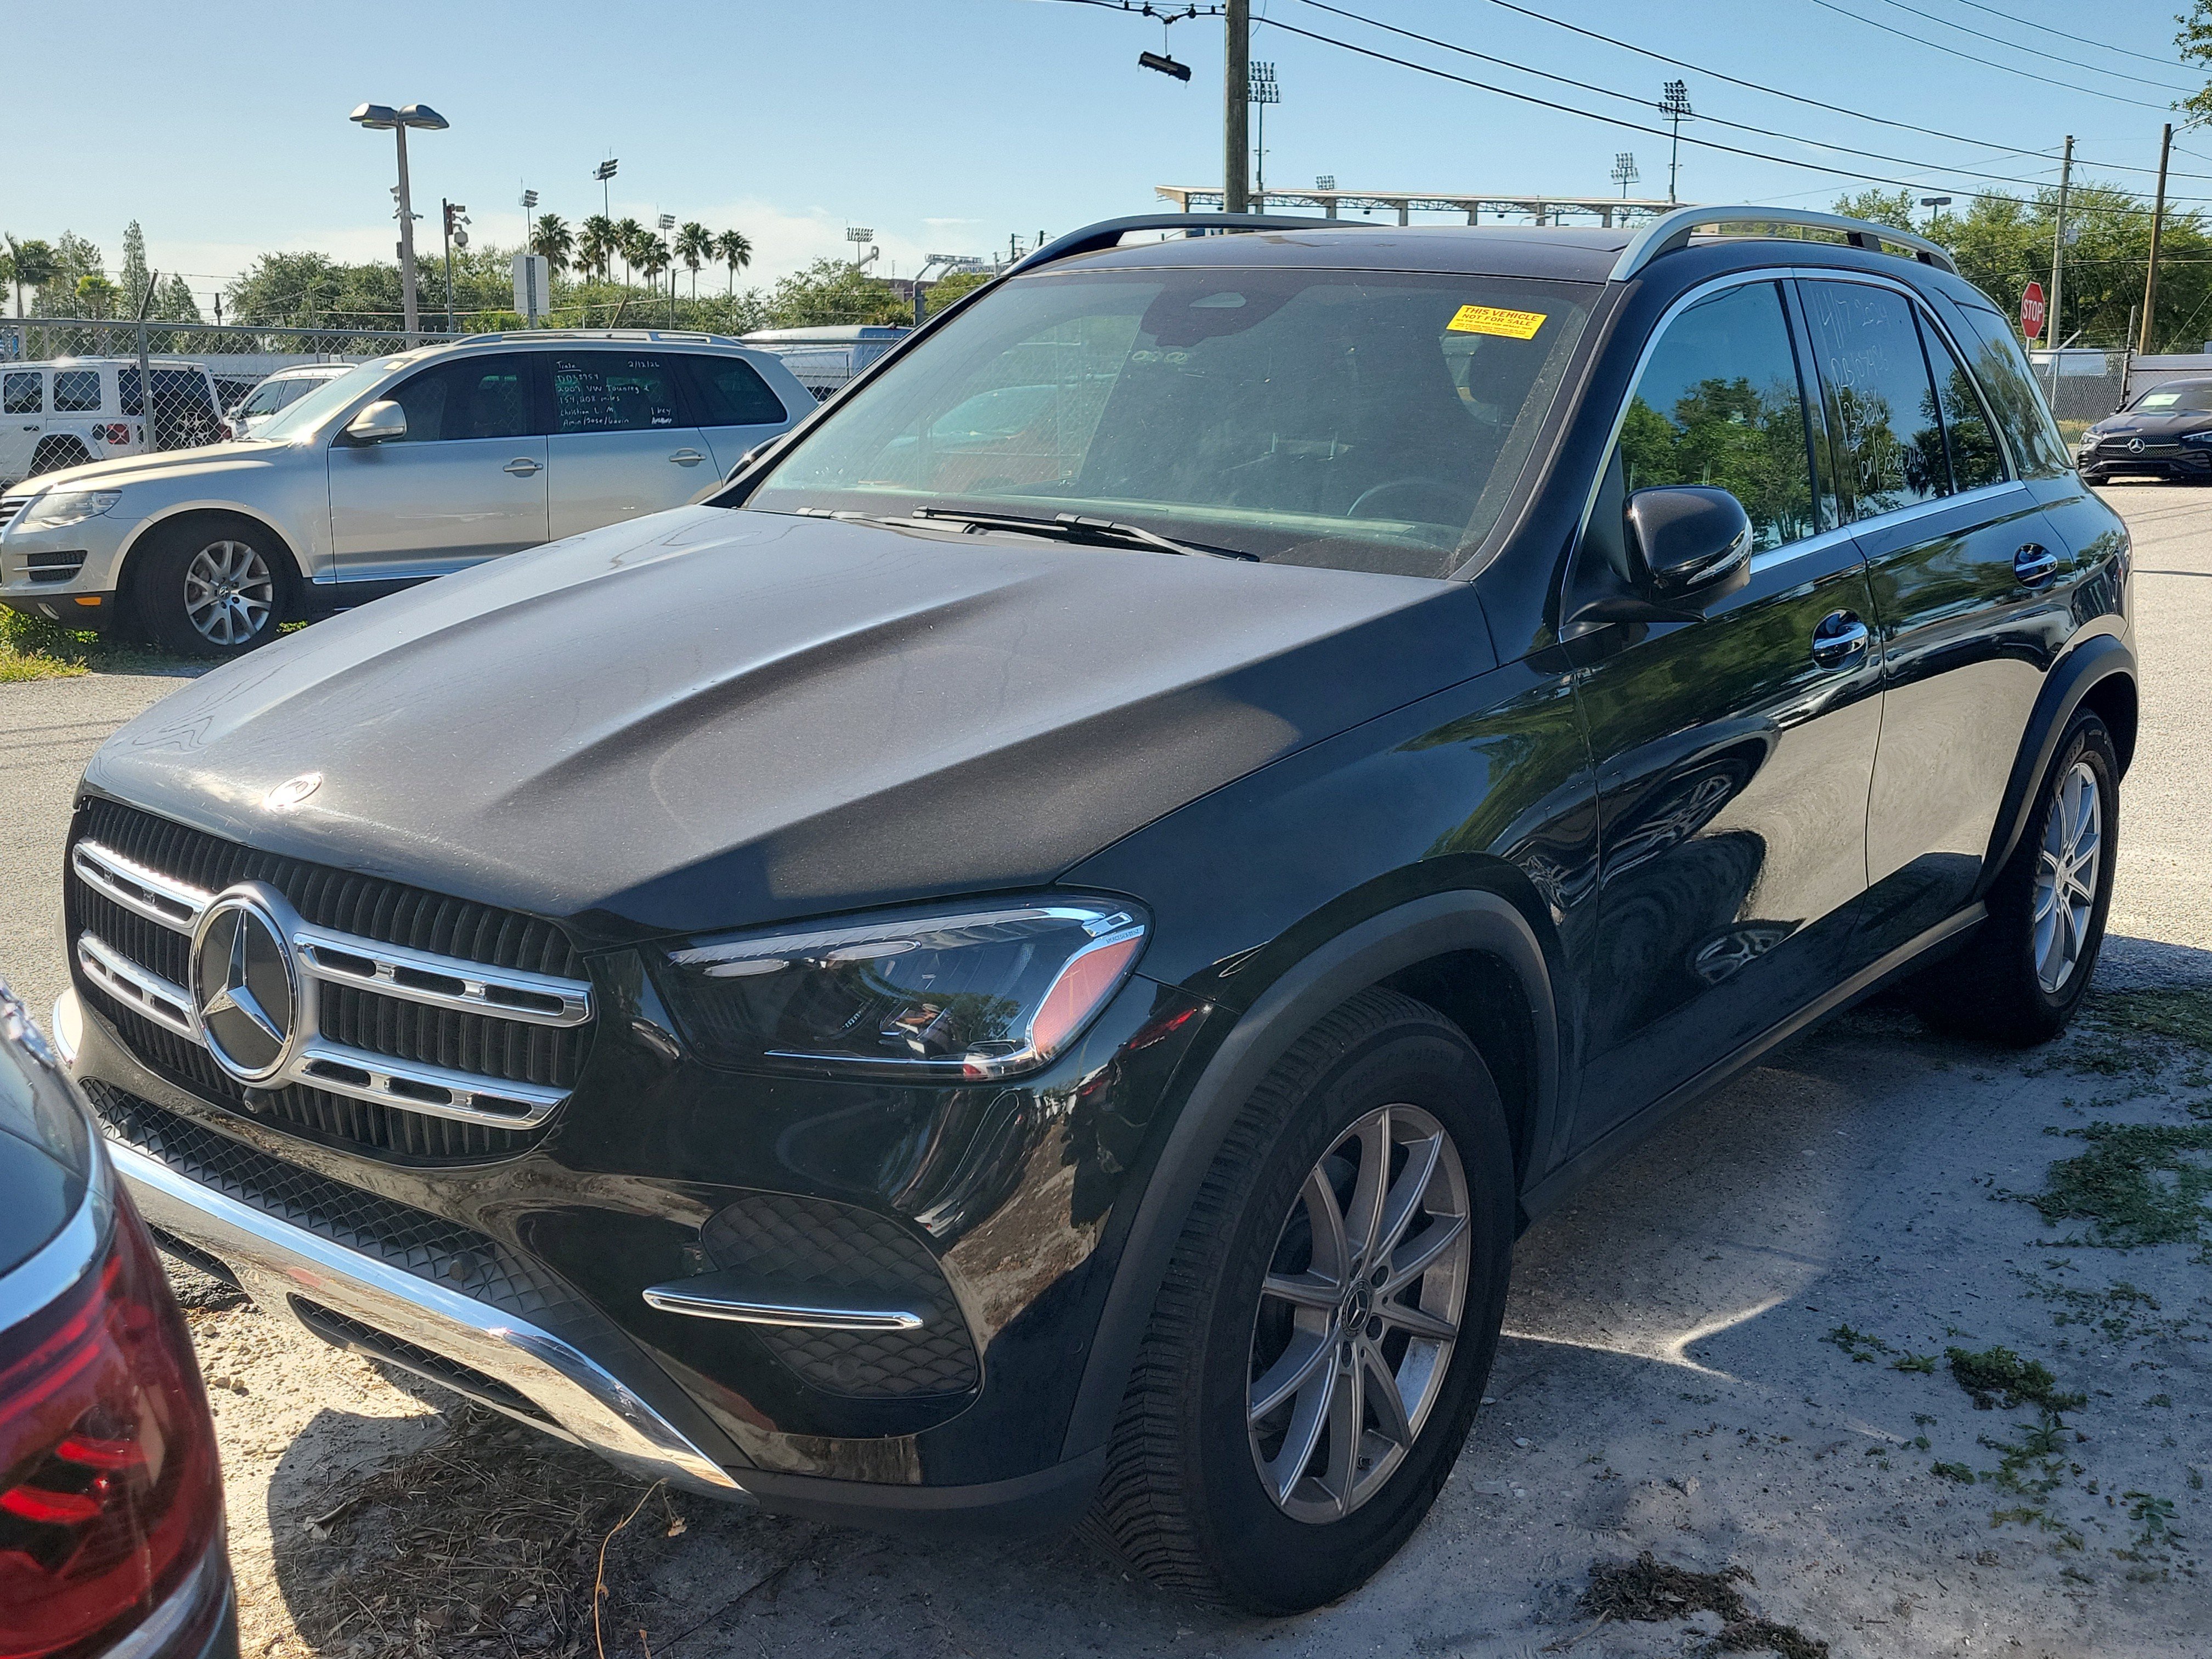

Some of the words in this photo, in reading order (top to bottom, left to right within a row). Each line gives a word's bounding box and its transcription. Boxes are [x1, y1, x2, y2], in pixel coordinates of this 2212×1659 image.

[1464, 307, 1489, 315] THIS
[1492, 310, 1540, 321] VEHICLE
[2023, 298, 2043, 322] STOP
[657, 407, 672, 416] key
